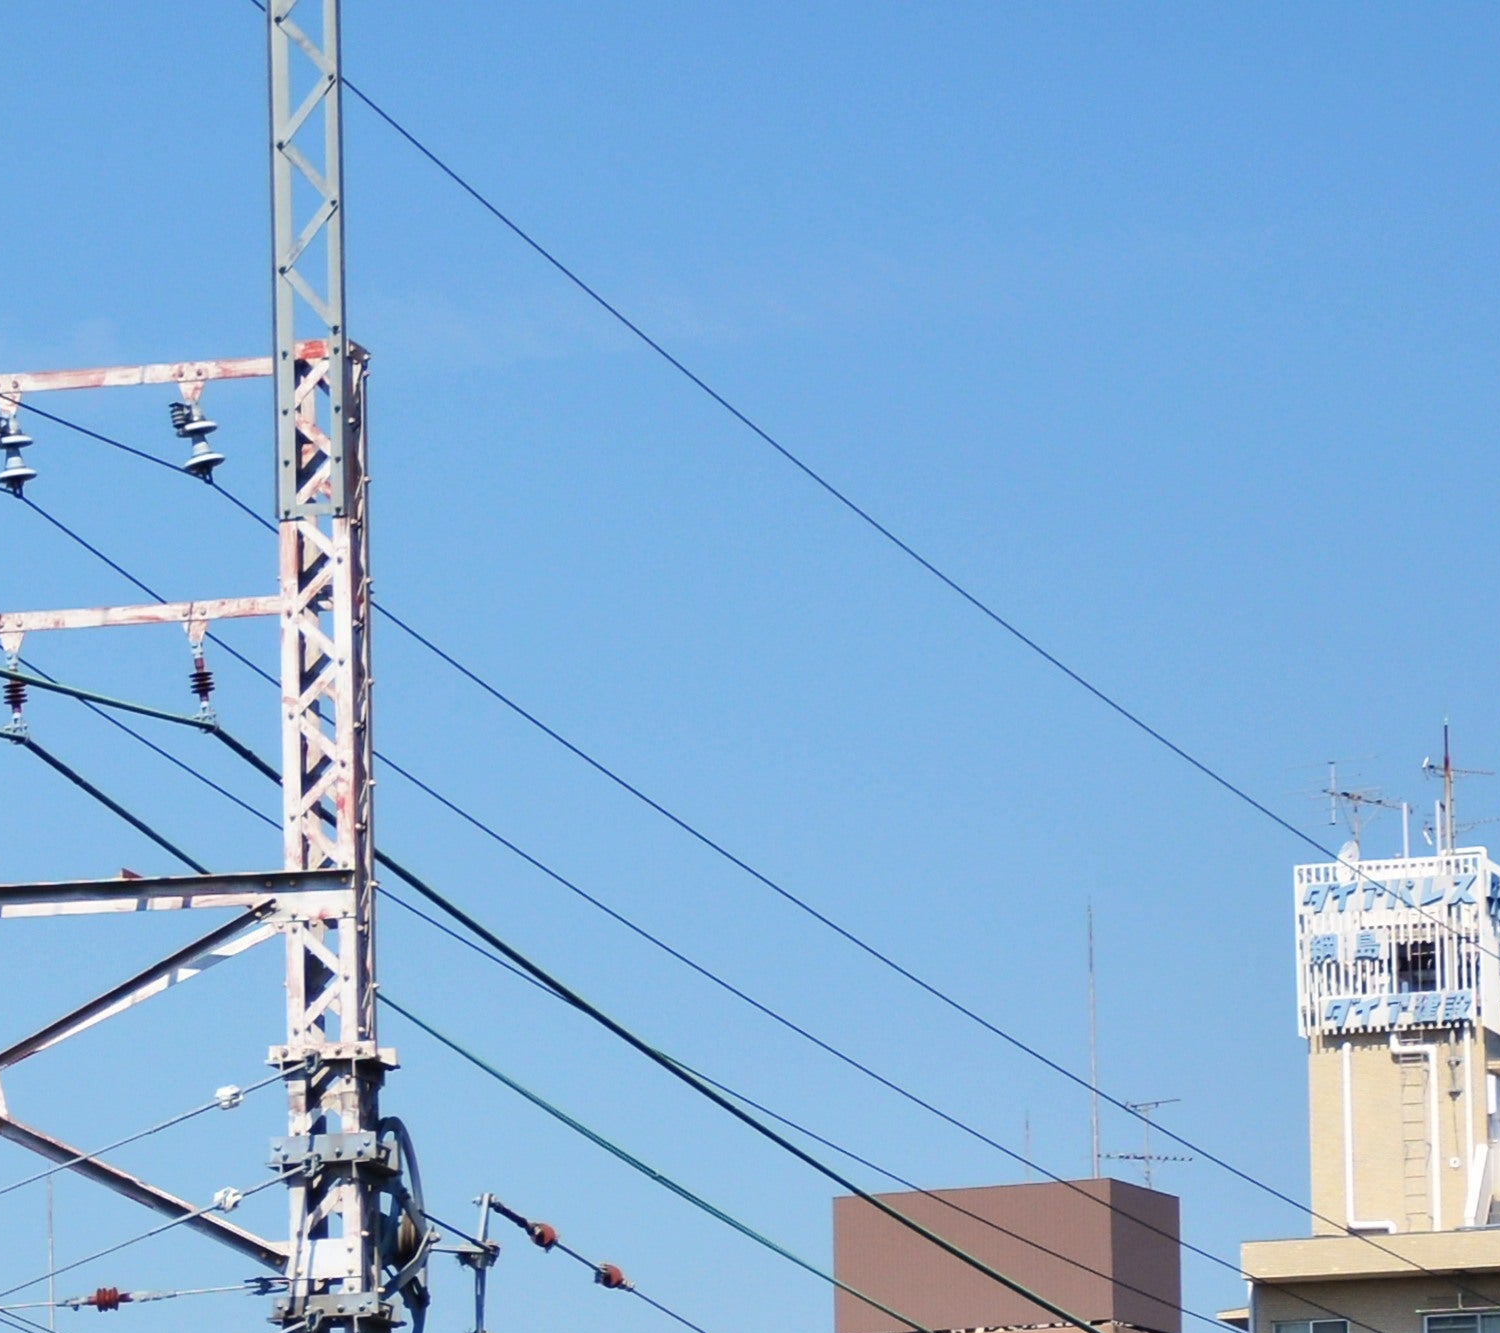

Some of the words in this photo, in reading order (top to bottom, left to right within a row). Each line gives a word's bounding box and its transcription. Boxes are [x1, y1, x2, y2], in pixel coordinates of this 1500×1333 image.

[1303, 875, 1477, 914] ダイアパレス
